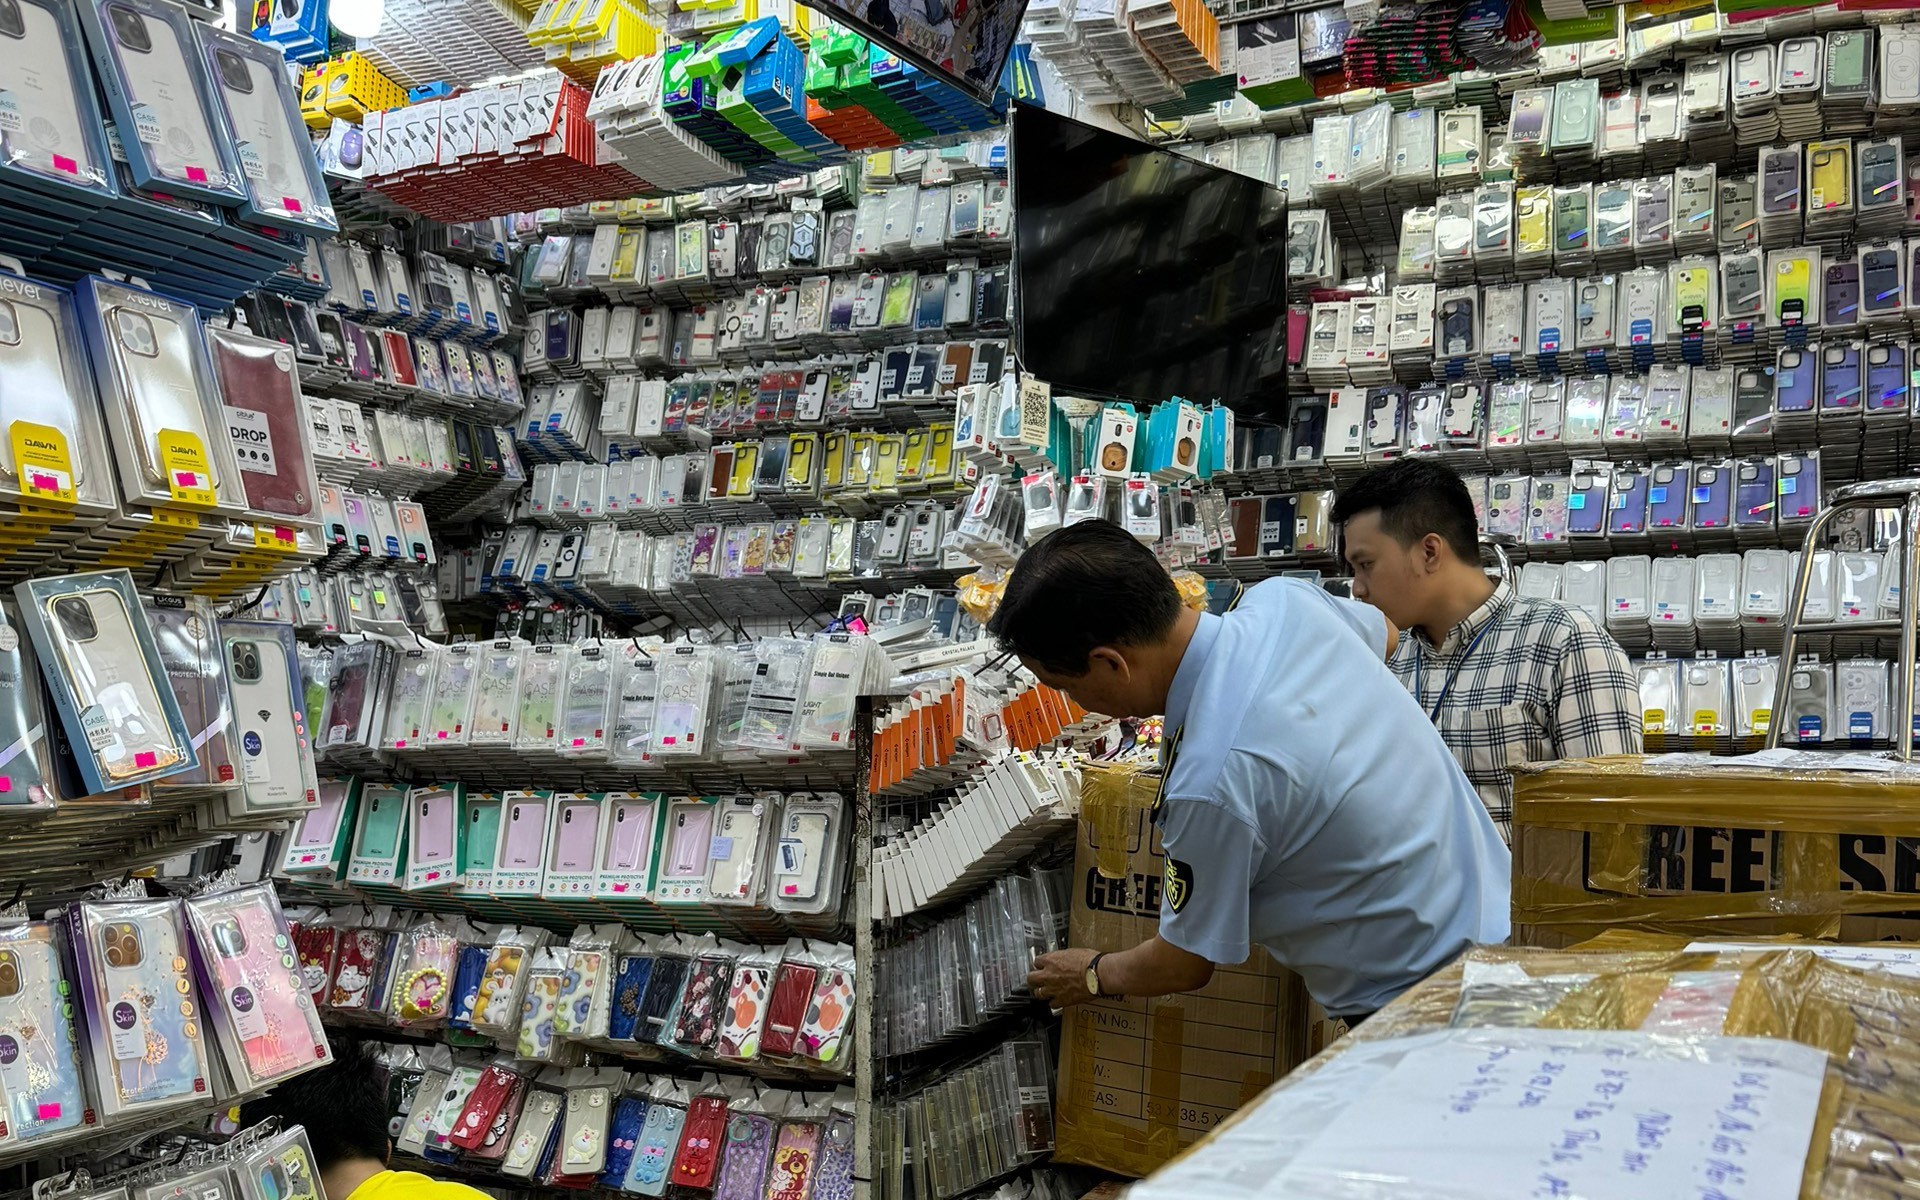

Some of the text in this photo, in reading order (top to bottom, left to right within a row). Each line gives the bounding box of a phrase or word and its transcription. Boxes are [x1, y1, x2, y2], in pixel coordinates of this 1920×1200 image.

[136, 112, 157, 123] CASE
[241, 150, 260, 160] CASE
[230, 426, 267, 442] DROP
[24, 439, 57, 451] DAWN
[171, 445, 197, 456] DAWN
[942, 645, 976, 656] CRYSTAL PALACE
[438, 680, 467, 694] CASE
[482, 678, 512, 691] CASE
[524, 682, 556, 696] CASE
[395, 685, 422, 699] CASE
[662, 685, 697, 699] CASE
[85, 715, 105, 727] CASE
[245, 738, 260, 750] Skin
[234, 995, 253, 1008] Skin
[116, 1010, 135, 1023] Skin
[1081, 1009, 1136, 1031] CTN No.:
[1077, 1087, 1117, 1107] MEAS:
[1146, 1102, 1162, 1115] 53
[1180, 1108, 1210, 1124] 38.5
